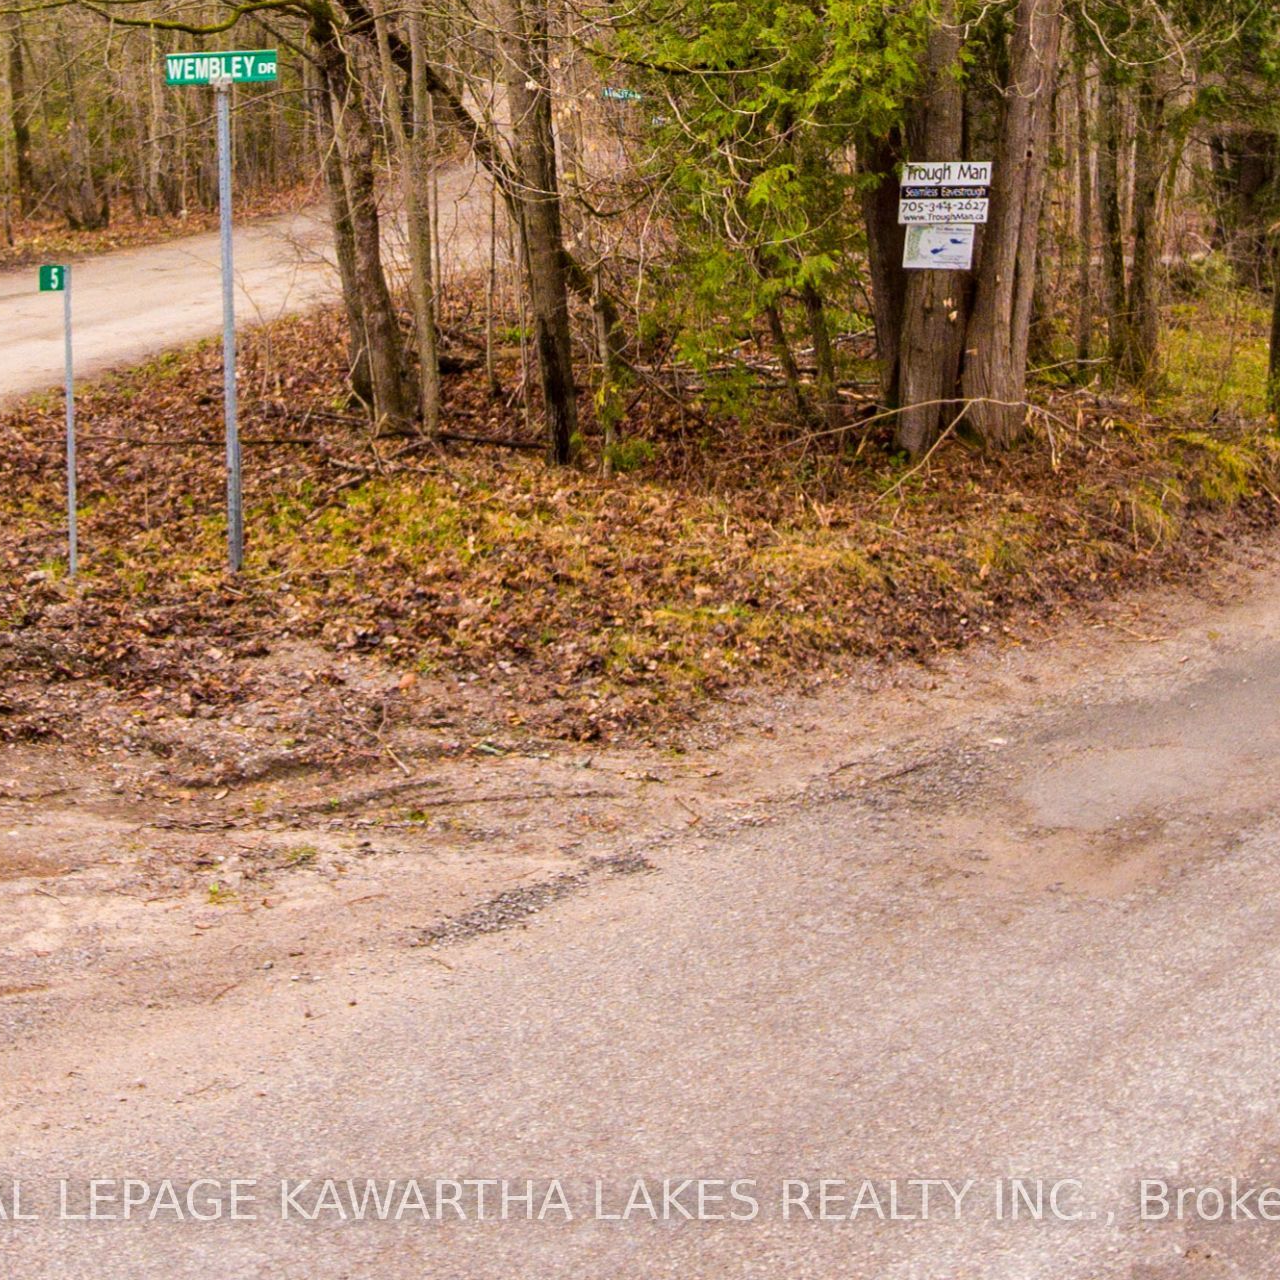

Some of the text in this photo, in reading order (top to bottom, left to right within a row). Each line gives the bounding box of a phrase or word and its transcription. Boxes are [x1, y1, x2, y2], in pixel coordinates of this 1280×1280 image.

[167, 56, 276, 80] WEMBLEY DR
[906, 163, 987, 184] Trough Man
[905, 186, 986, 198] Seamless Eavestrough
[902, 200, 986, 213] 705-344-2627
[904, 213, 984, 223] www.TroughMan.ca
[51, 268, 59, 289] 5
